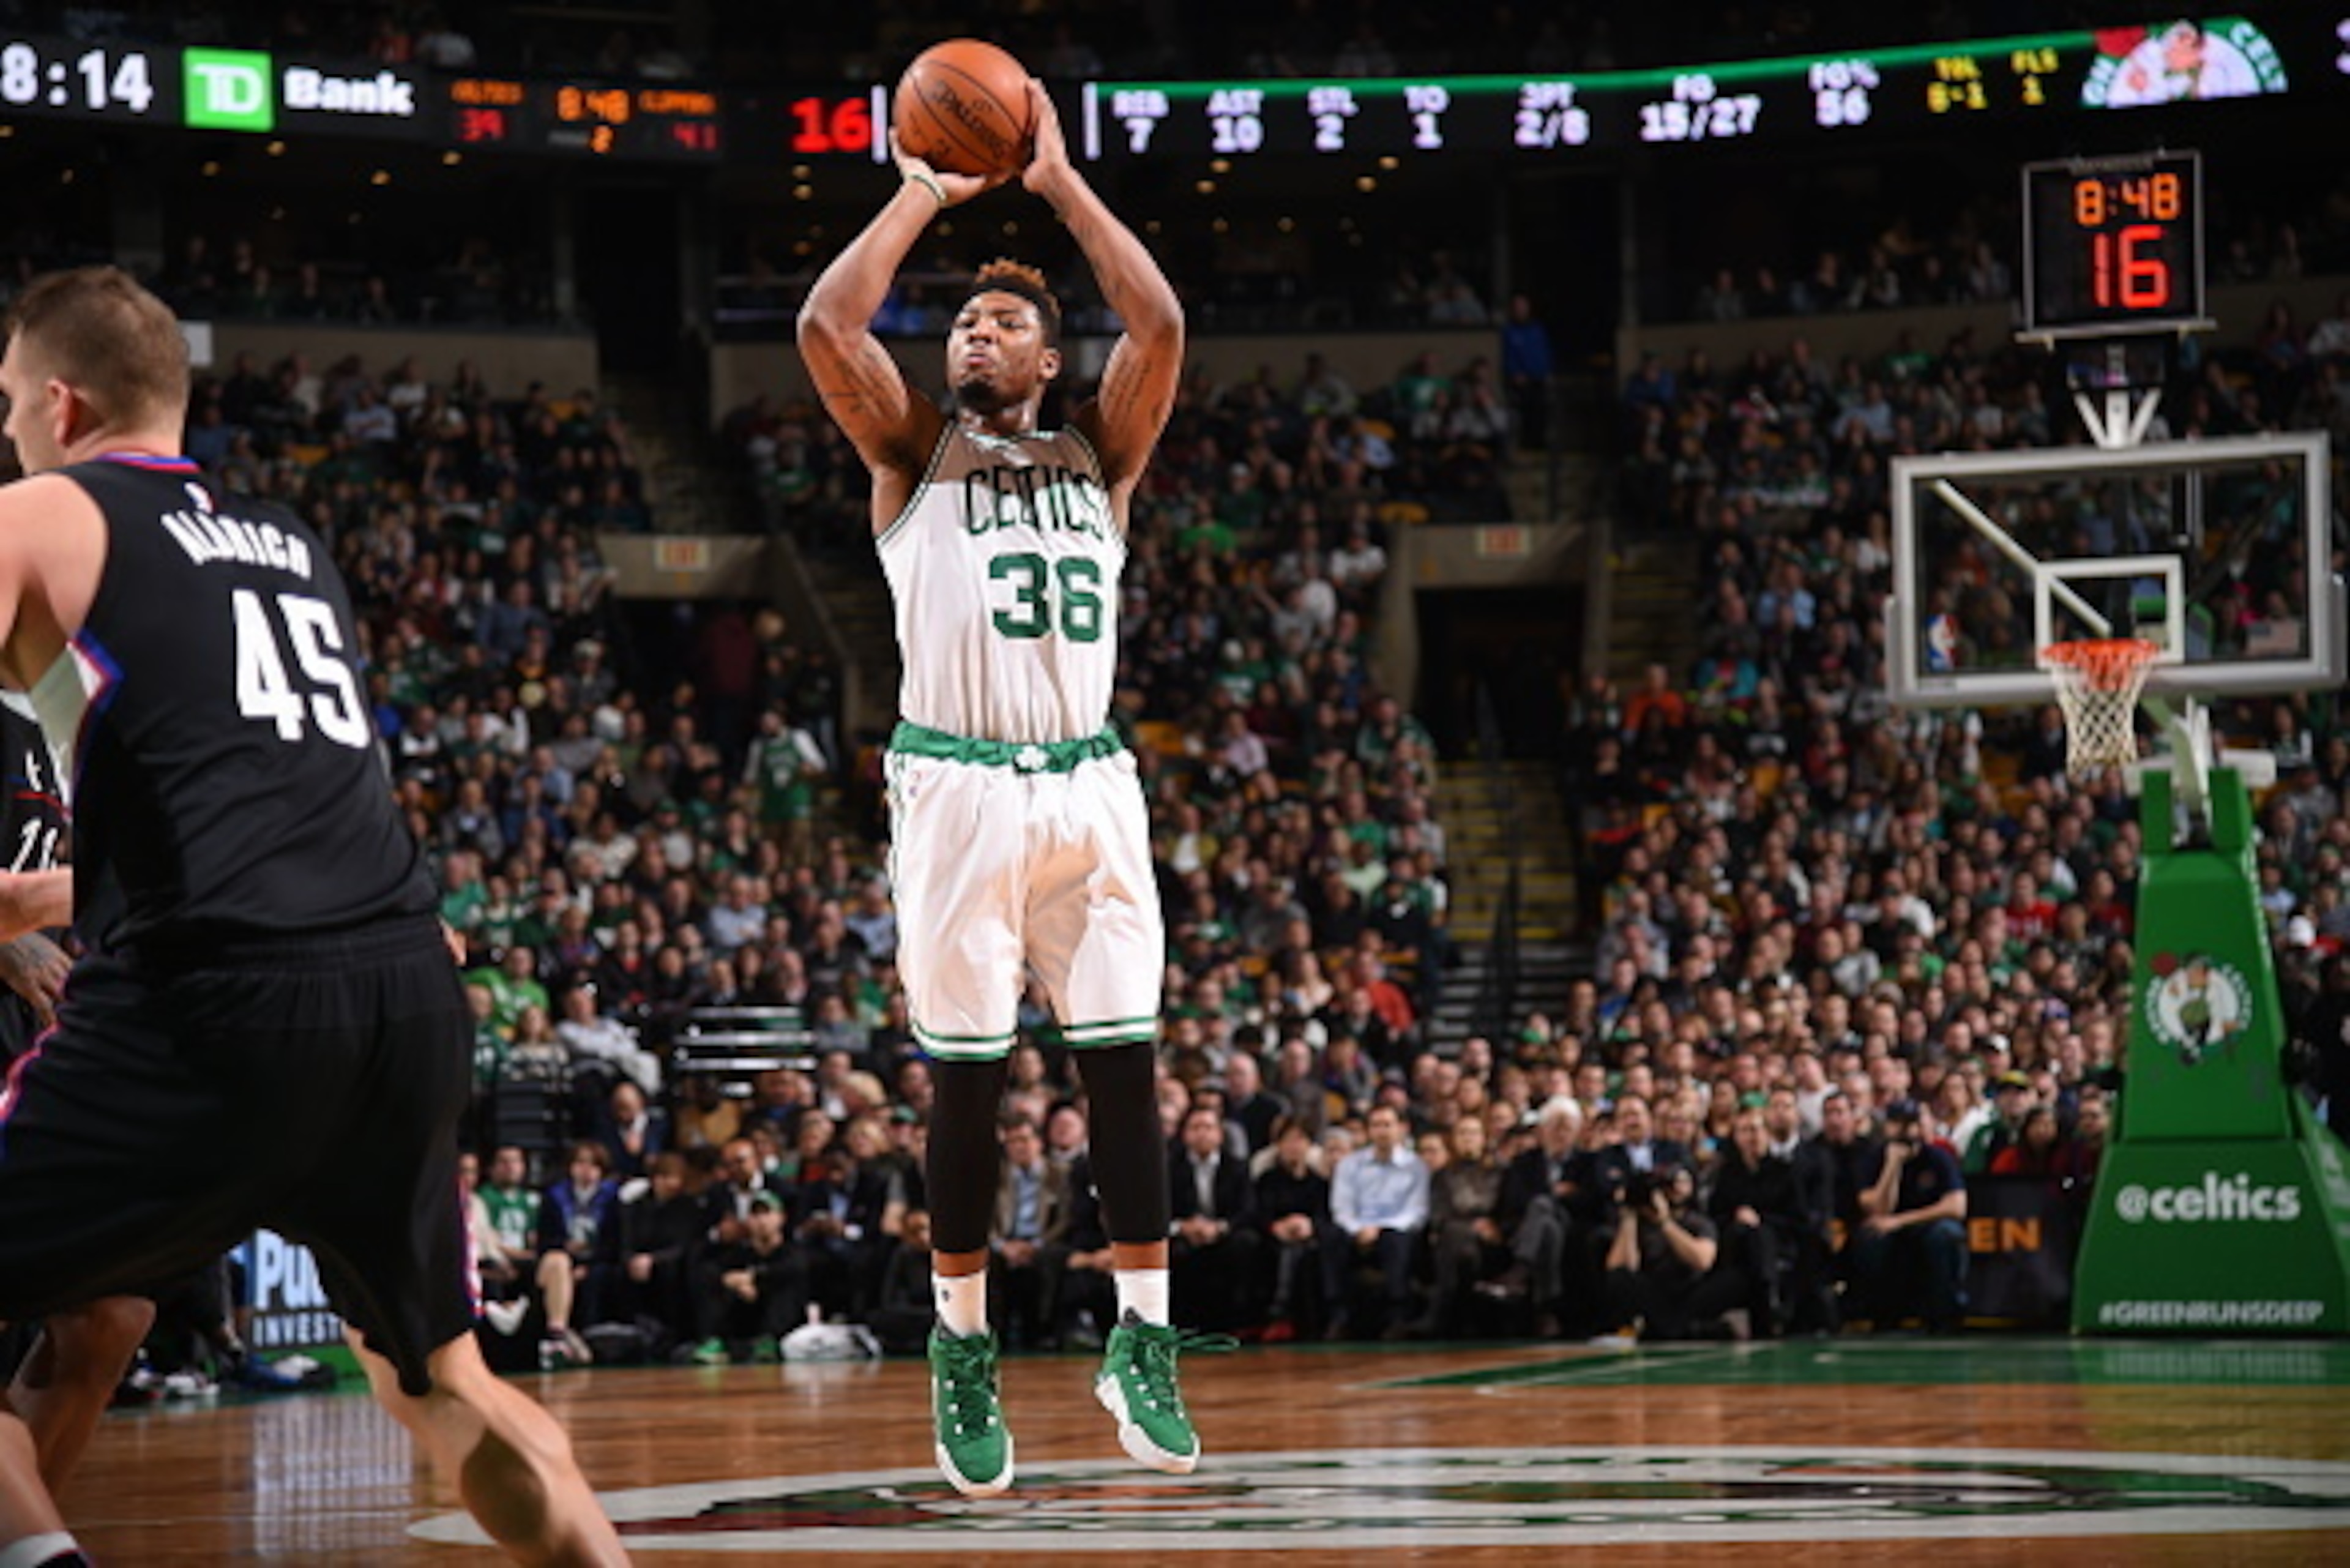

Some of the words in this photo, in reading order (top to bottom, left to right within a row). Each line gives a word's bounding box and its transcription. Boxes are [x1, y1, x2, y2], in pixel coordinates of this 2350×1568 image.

[192, 64, 265, 113] TD
[283, 67, 414, 115] Bank
[1206, 89, 1264, 115] AST
[1403, 85, 1449, 113] TO
[792, 97, 872, 152] 16
[1125, 117, 1154, 152] 7
[1212, 116, 1263, 152] 10
[1315, 113, 1345, 150] 2
[1413, 112, 1442, 149] 1
[2075, 173, 2181, 226] 8:48
[2094, 225, 2168, 307] 16
[988, 552, 1103, 643] 36
[232, 589, 370, 749] 45
[2116, 1170, 2301, 1222] @celtics
[2098, 1299, 2325, 1327] #GREENRUNSDEEP
